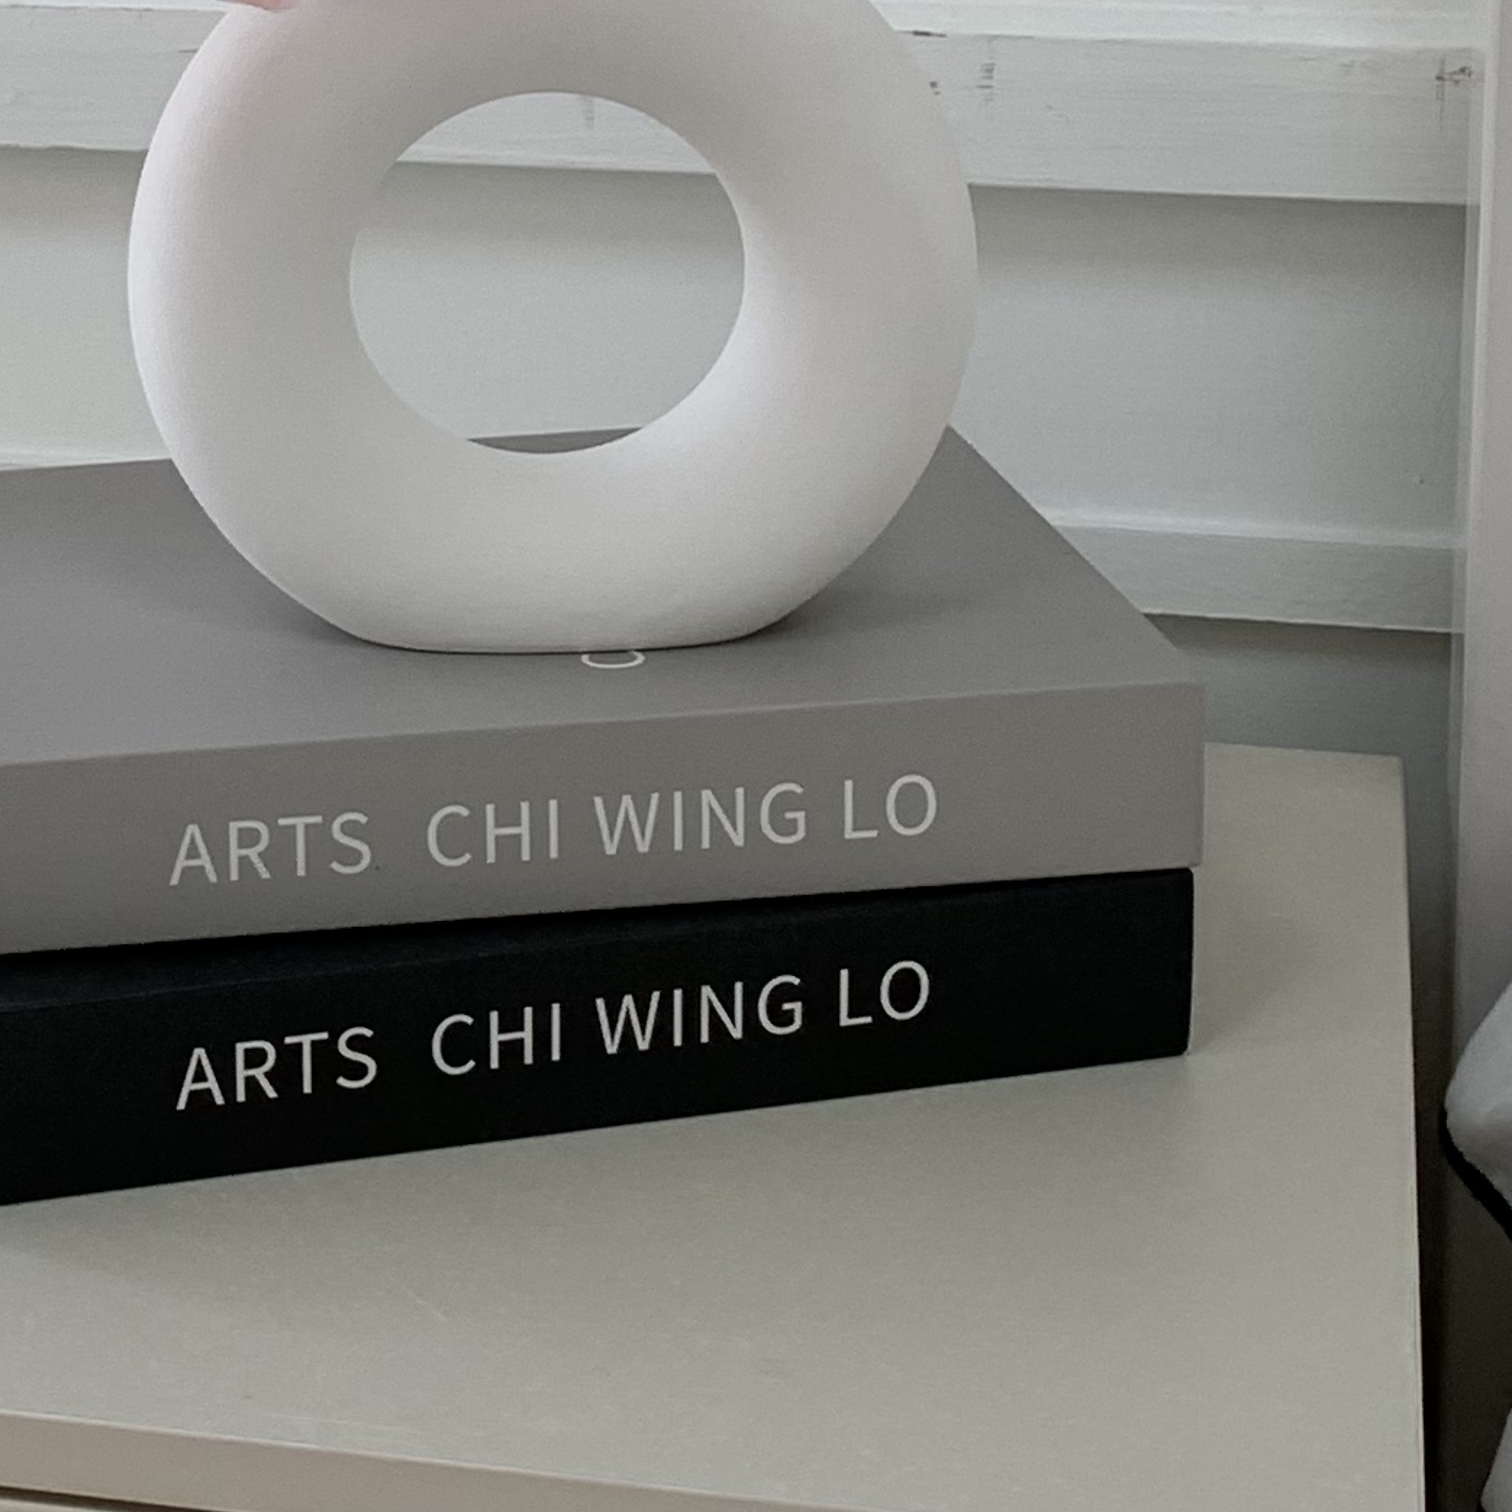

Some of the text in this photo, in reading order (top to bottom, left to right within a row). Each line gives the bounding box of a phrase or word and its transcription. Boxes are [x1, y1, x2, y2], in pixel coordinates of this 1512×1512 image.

[169, 774, 937, 886] ARTS CHI WING LO
[175, 959, 931, 1112] ARTS CHI WING LO
